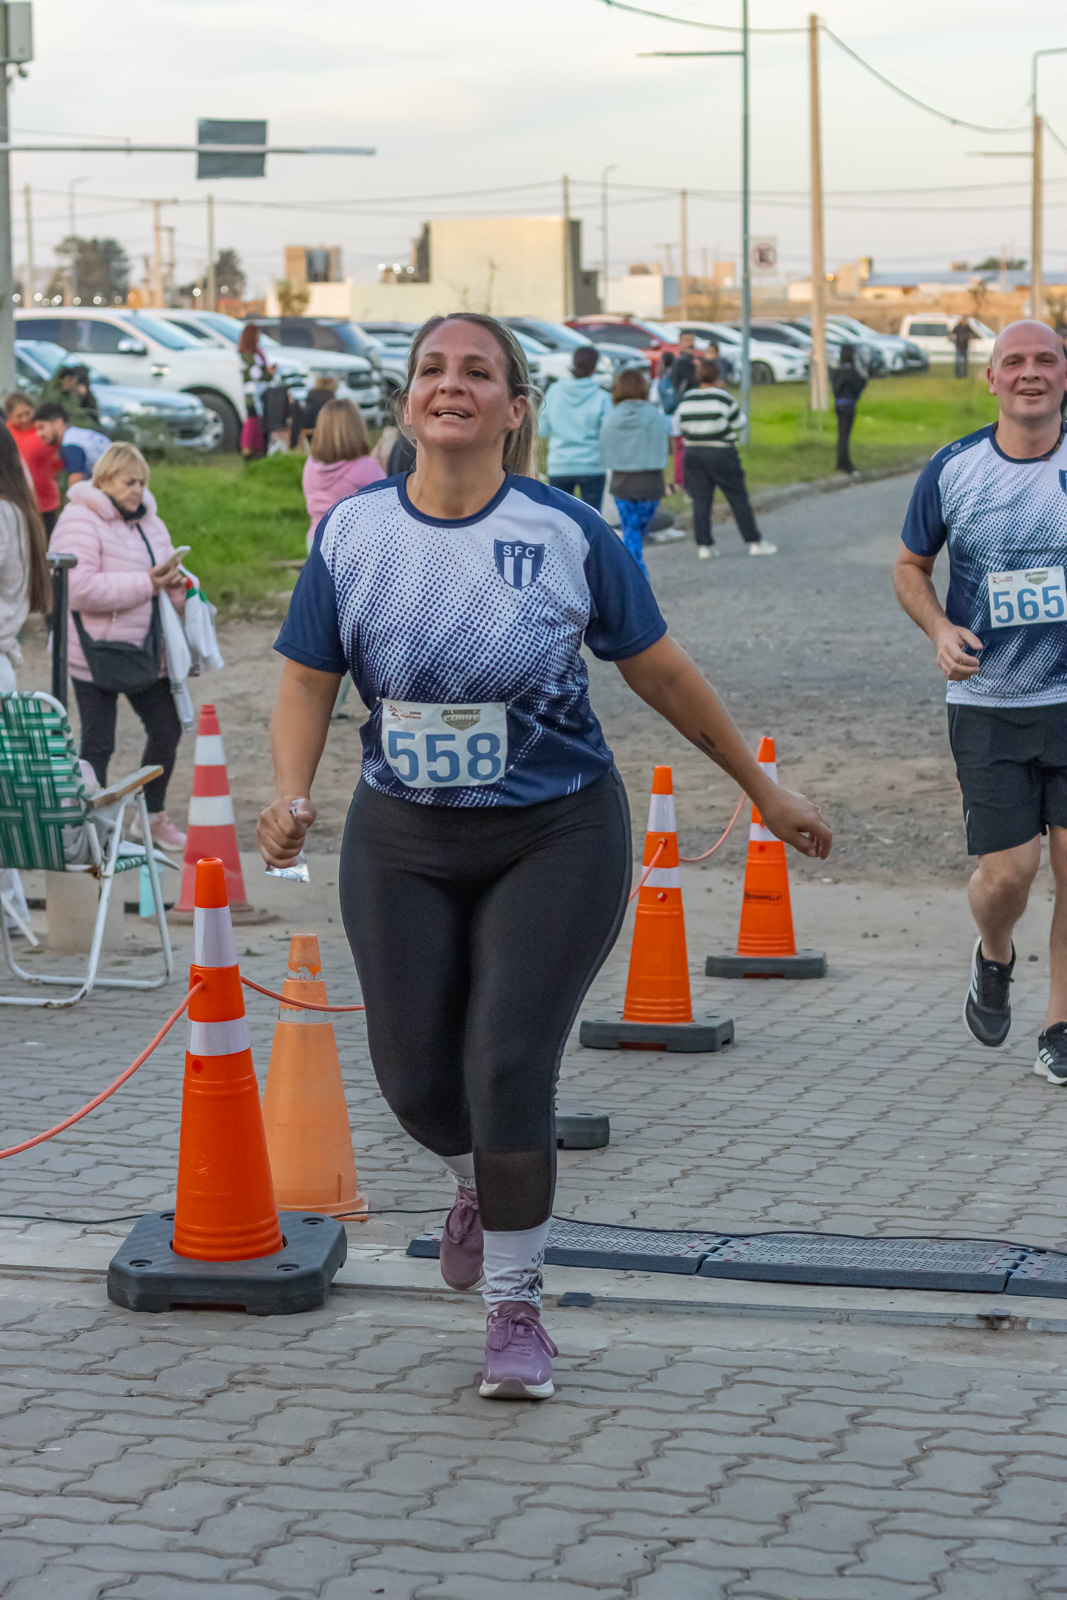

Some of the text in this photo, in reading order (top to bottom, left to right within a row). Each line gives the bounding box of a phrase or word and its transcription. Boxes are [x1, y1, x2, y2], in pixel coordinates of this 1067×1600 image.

[502, 545, 535, 558] SFC
[993, 585, 1064, 624] 565
[388, 730, 501, 783] 558
